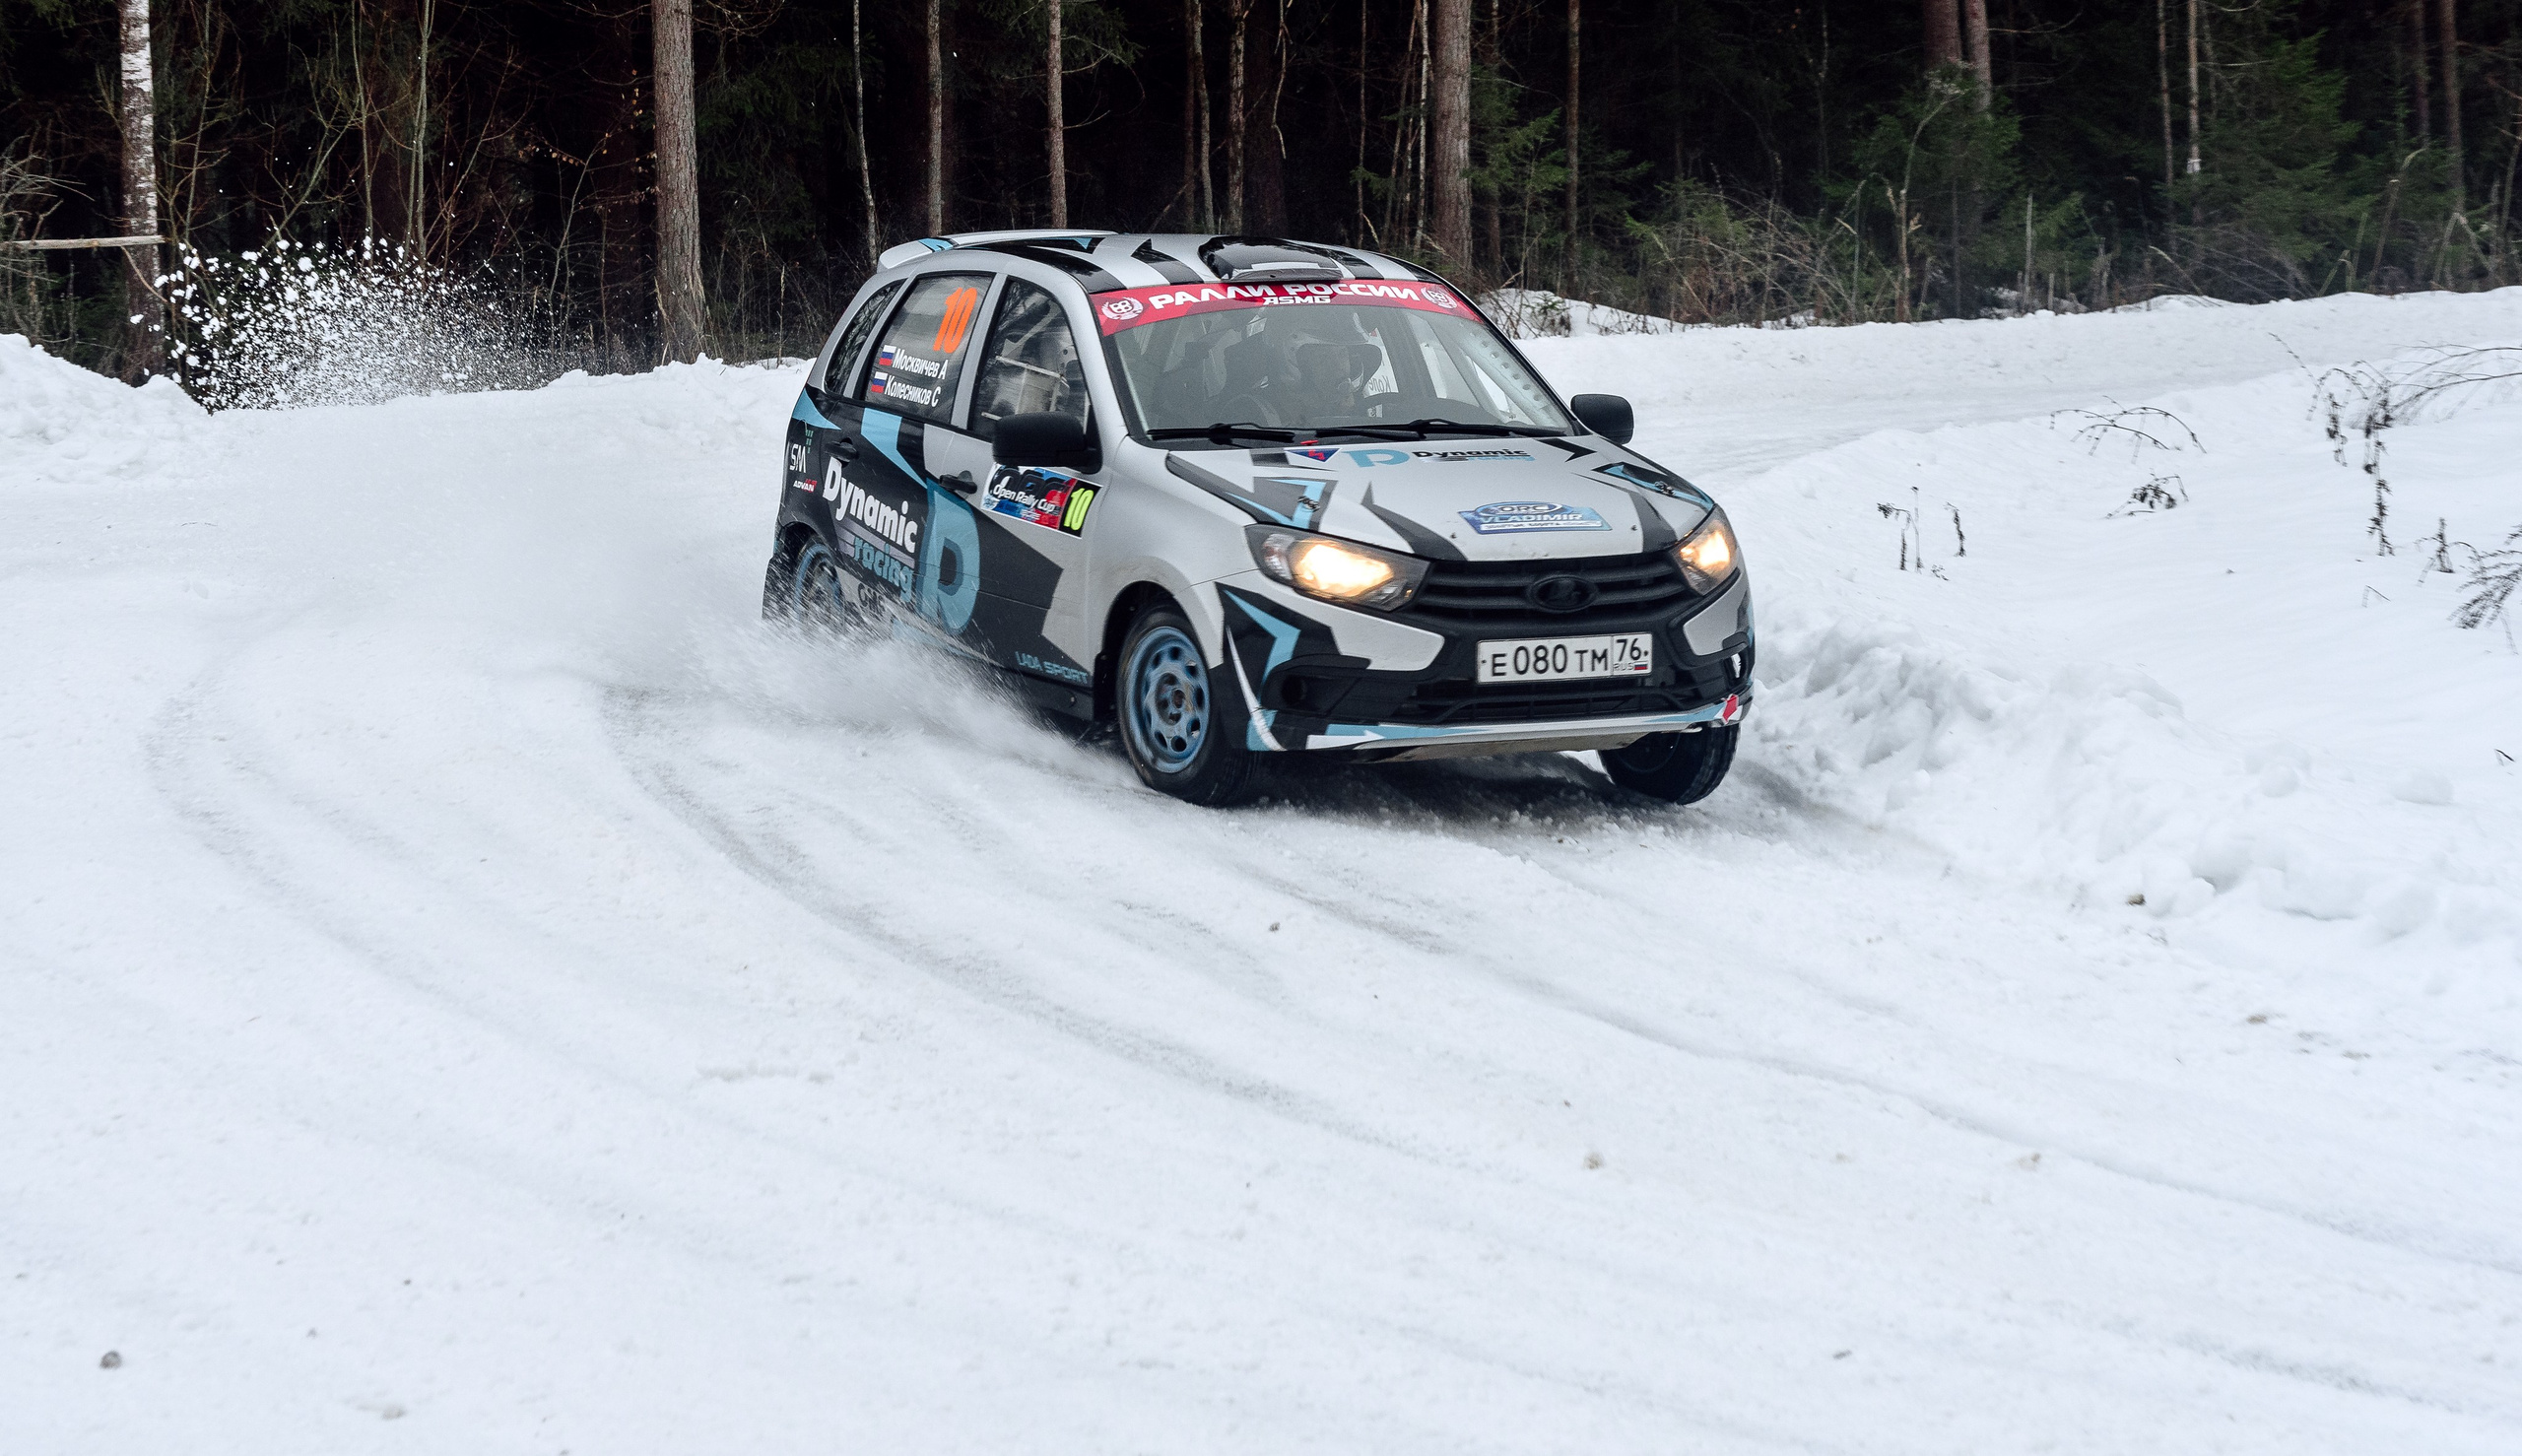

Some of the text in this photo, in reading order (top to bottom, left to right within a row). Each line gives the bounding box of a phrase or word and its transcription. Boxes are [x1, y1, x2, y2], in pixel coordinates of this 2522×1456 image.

[1149, 285, 1276, 309] РАЛЛИ
[1283, 283, 1421, 301] РОССИИ
[933, 287, 977, 354] 10
[892, 348, 949, 379] Москвичев А
[884, 374, 941, 407] Колесников С
[1412, 448, 1528, 457] Dynamic
[793, 479, 815, 493] ADVAN
[993, 484, 1057, 513] Open Rally Cup
[822, 456, 918, 554] Dynamic
[1063, 488, 1094, 531] 10
[1480, 513, 1583, 523] VLADIMIR
[854, 536, 914, 603] racing
[1616, 638, 1641, 662] 76
[1043, 661, 1088, 684] SPORT
